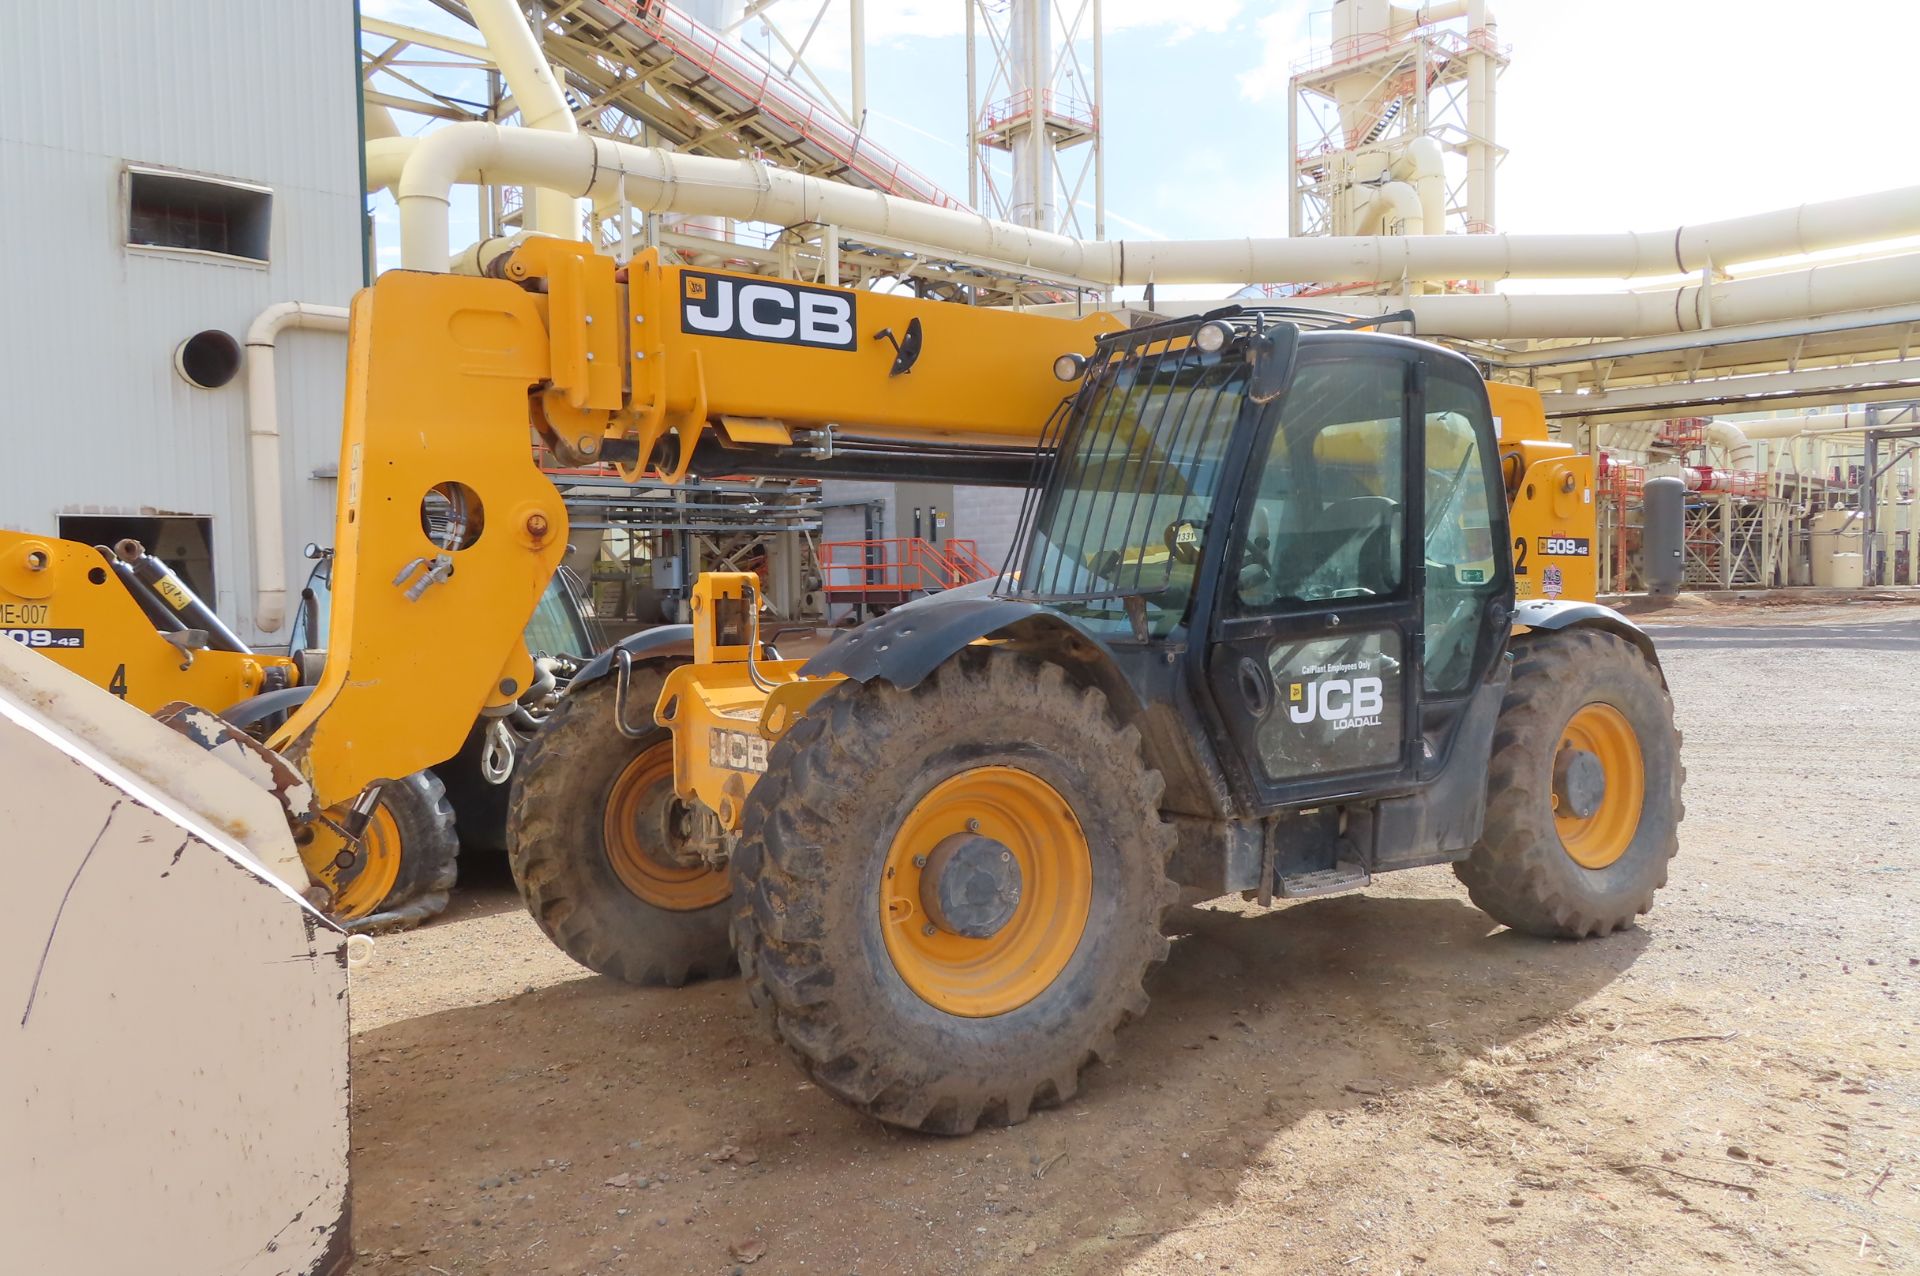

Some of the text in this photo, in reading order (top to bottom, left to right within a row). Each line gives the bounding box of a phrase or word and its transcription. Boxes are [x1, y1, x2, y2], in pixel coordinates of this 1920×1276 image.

[686, 280, 853, 346] JCB
[1514, 536, 1528, 575] 2
[1547, 538, 1588, 554] 509-42
[0, 629, 80, 646] 09-42
[108, 663, 128, 700] 4
[1327, 662, 1357, 674] Employees
[1358, 660, 1371, 670] Only
[1290, 677, 1383, 724] JCB
[1333, 716, 1382, 730] LOADALL
[710, 731, 769, 772] JCB
